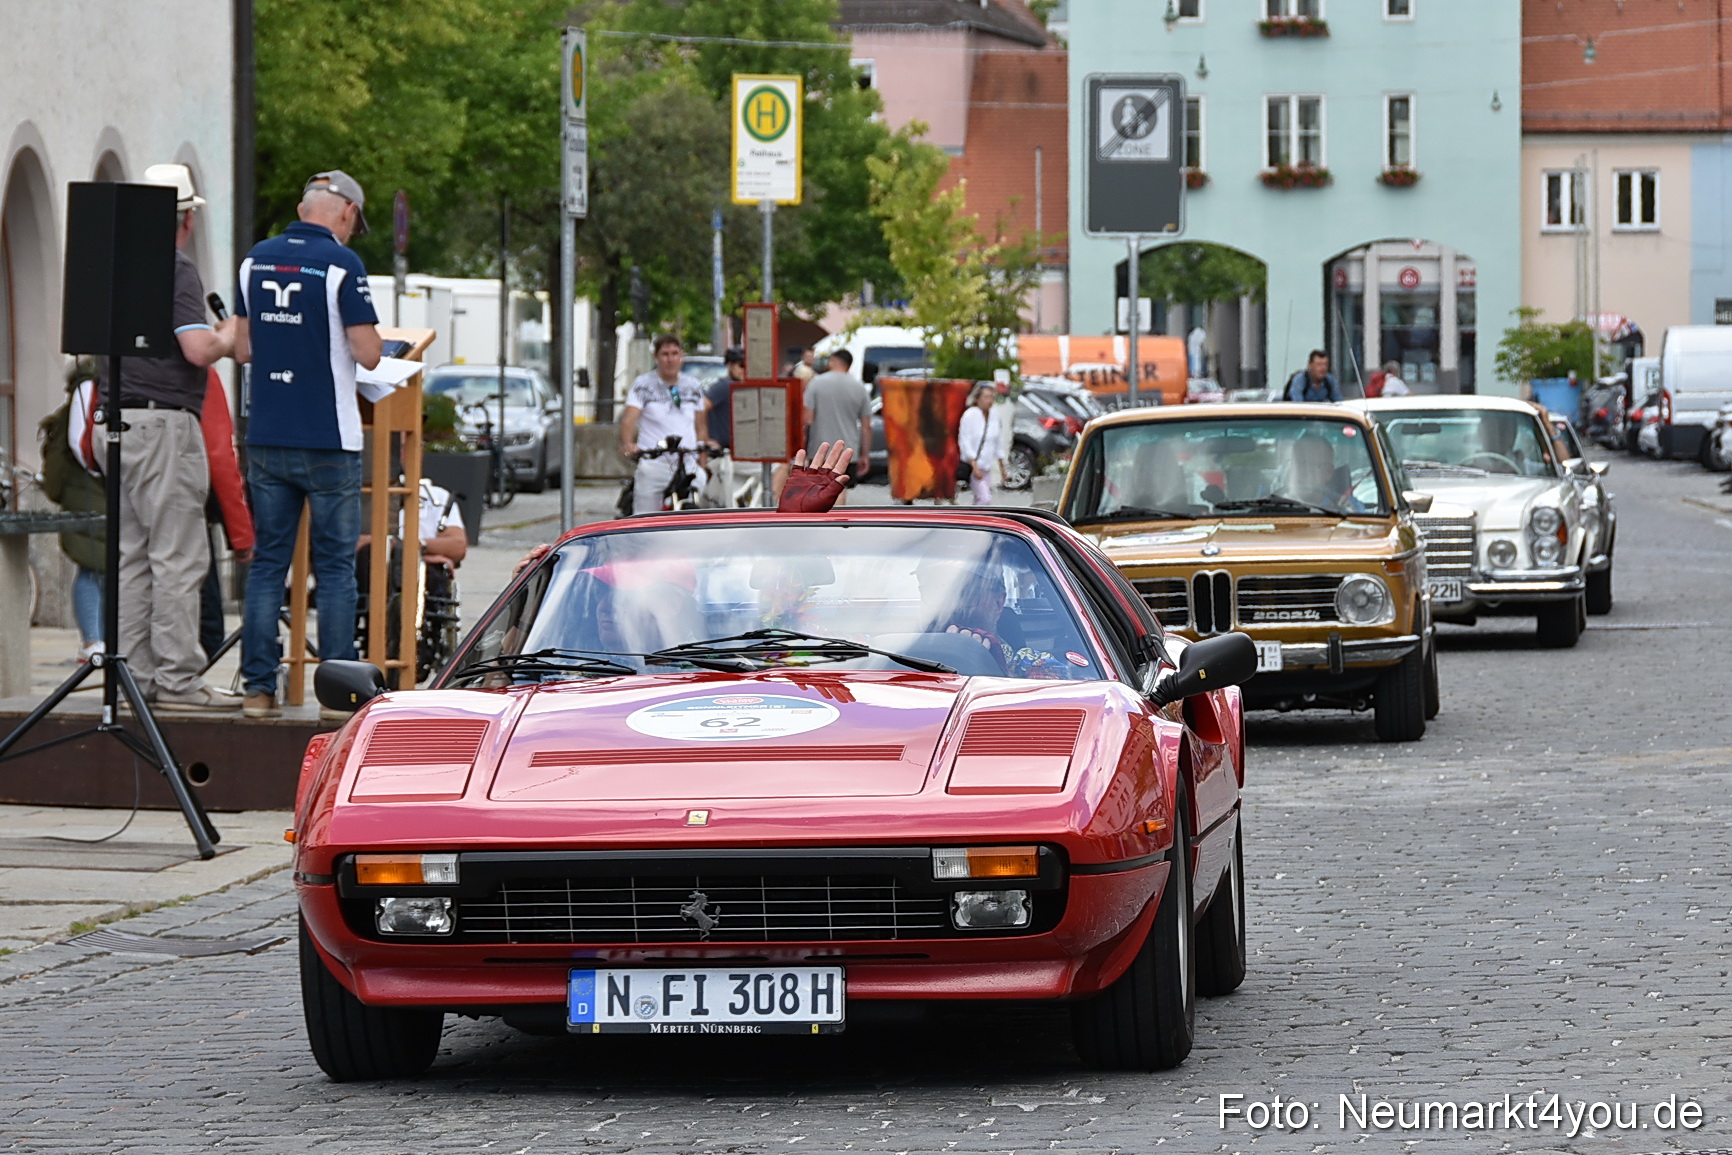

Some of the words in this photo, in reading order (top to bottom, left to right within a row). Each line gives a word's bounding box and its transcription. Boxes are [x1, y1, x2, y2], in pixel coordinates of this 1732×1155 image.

[757, 98, 777, 129] H
[1116, 143, 1151, 156] ZONE
[300, 266, 326, 278] RACING
[260, 311, 303, 325] randstad
[700, 717, 762, 728] 62
[607, 974, 631, 1017] N
[662, 974, 710, 1016] FI
[577, 1003, 589, 1015] D
